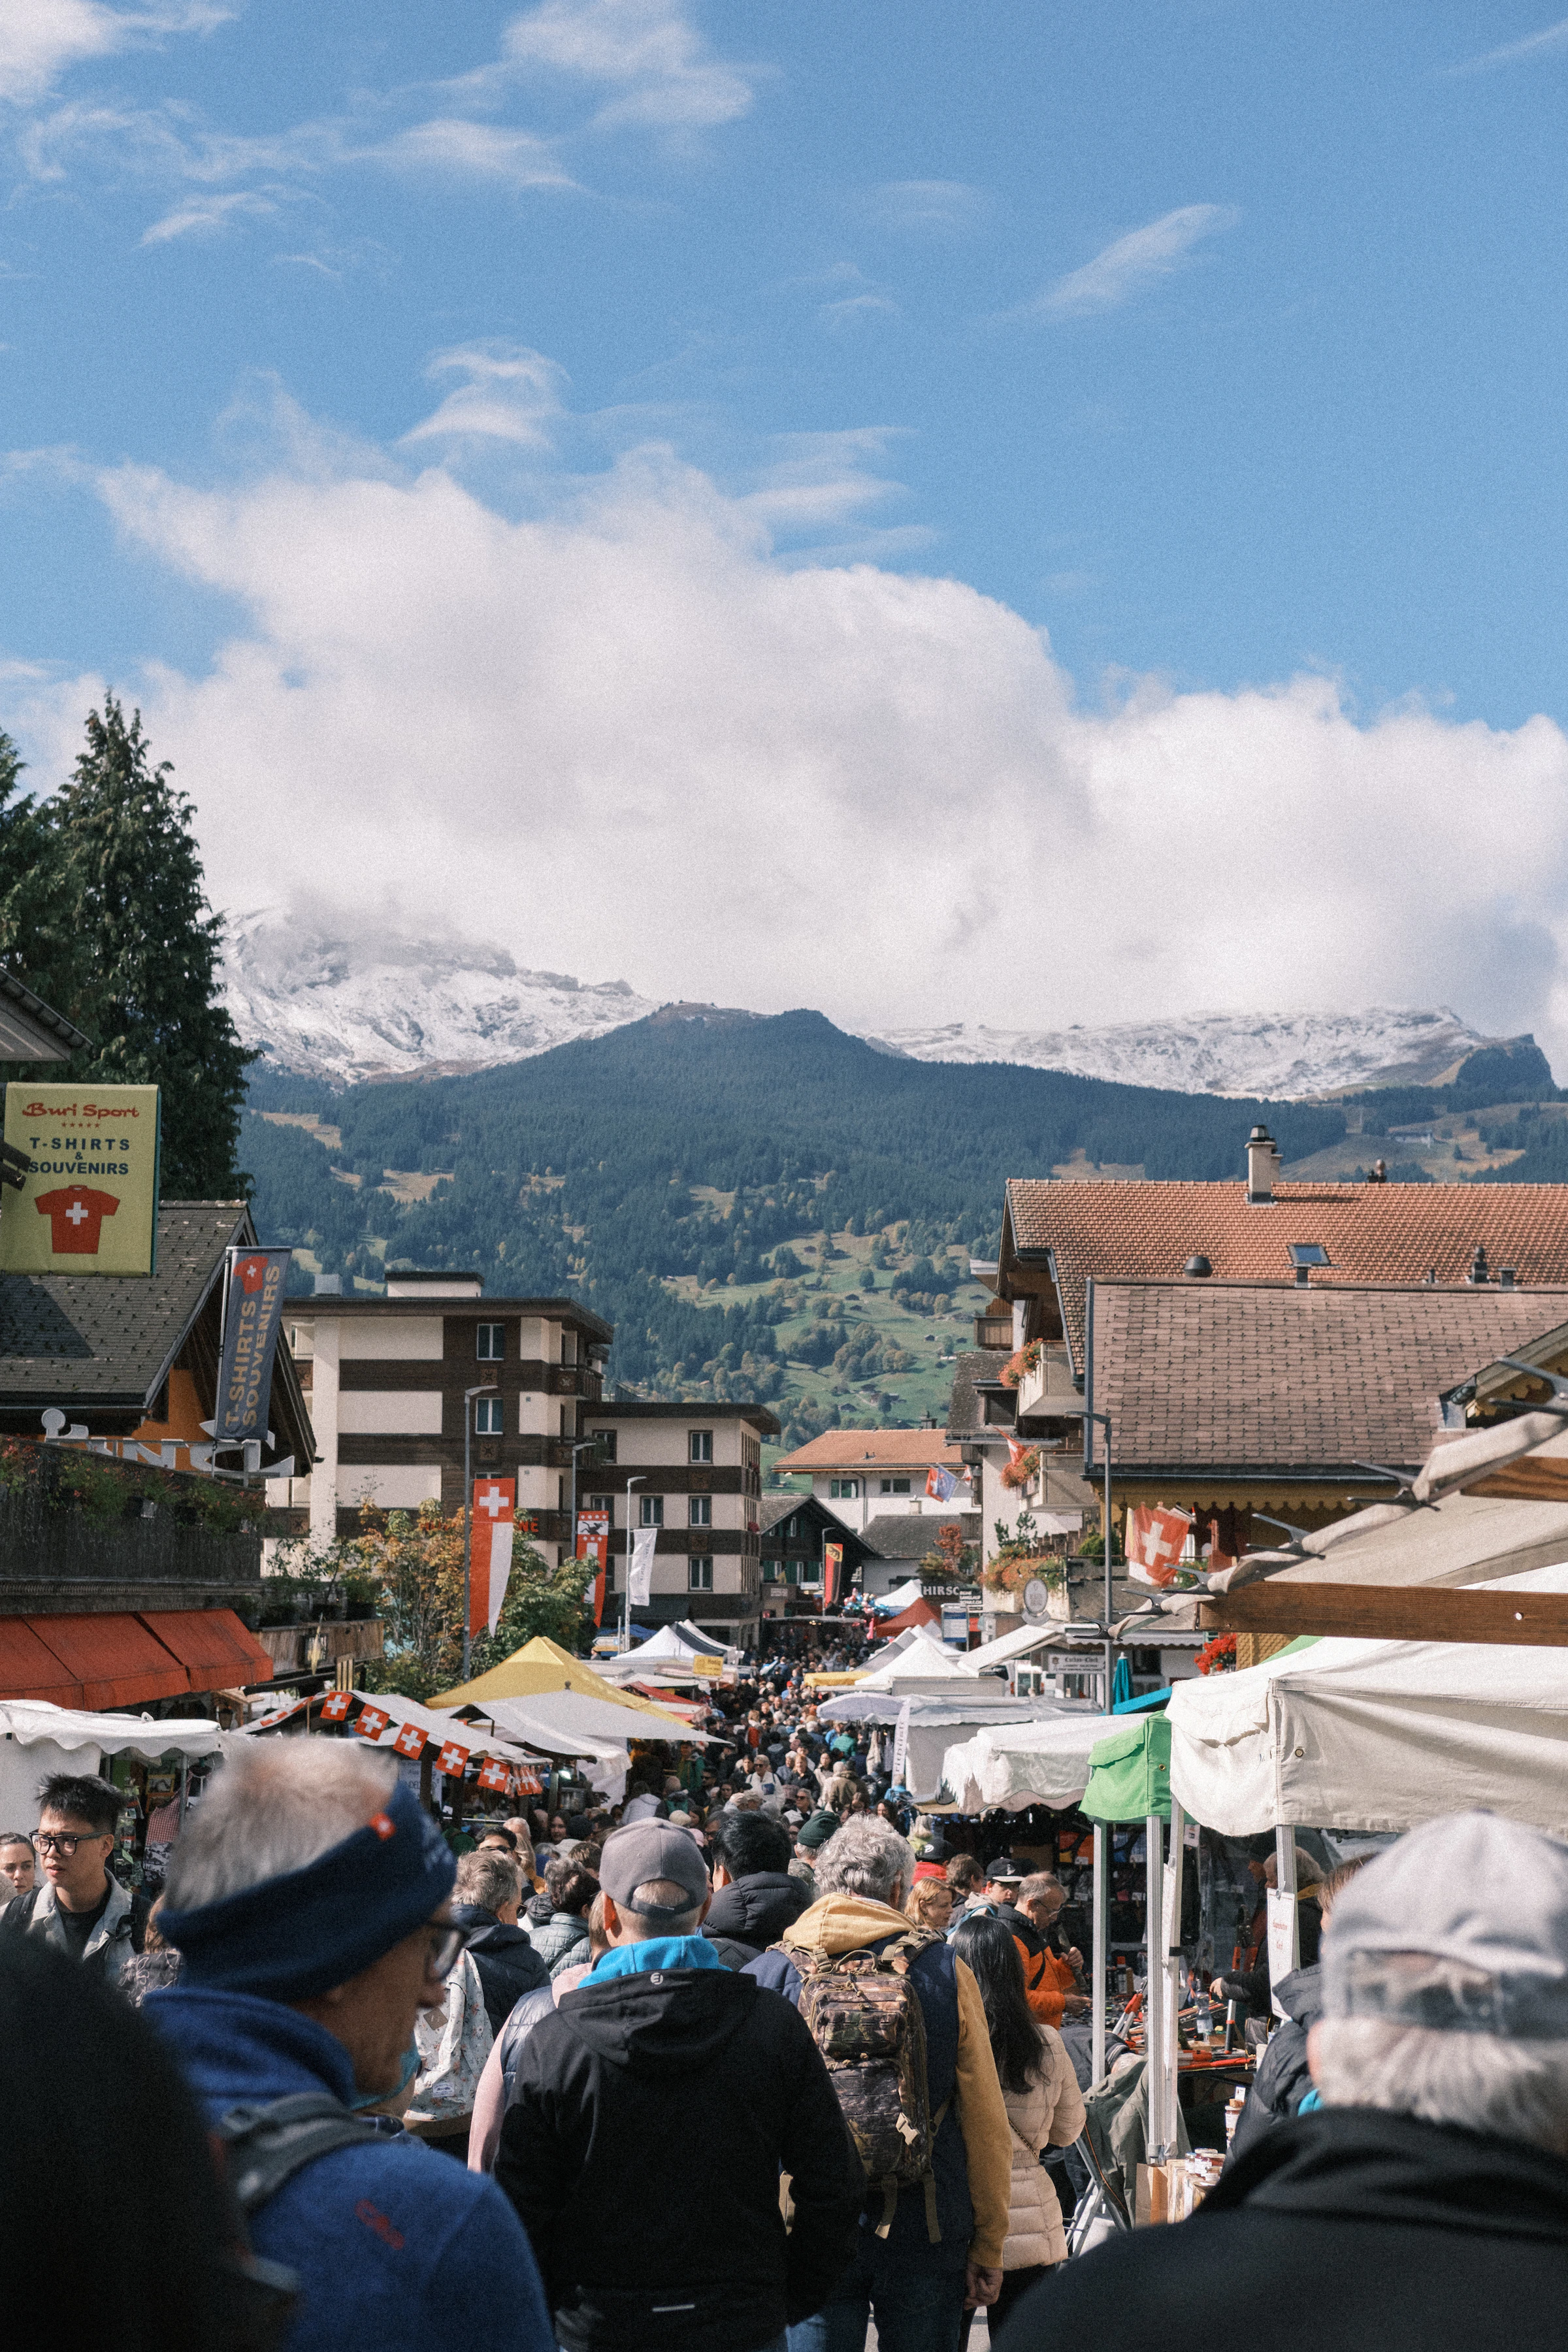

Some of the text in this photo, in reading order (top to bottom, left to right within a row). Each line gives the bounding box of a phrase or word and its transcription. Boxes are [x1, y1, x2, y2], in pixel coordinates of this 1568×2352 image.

[22, 1102, 140, 1119] Buri Sport
[29, 1137, 130, 1151] T-SHIRTS
[74, 1152, 84, 1160] &
[29, 1162, 129, 1175] SOUVENIRS
[242, 1265, 280, 1428] SOUVENIRS
[225, 1300, 256, 1428] T-SHIRTS
